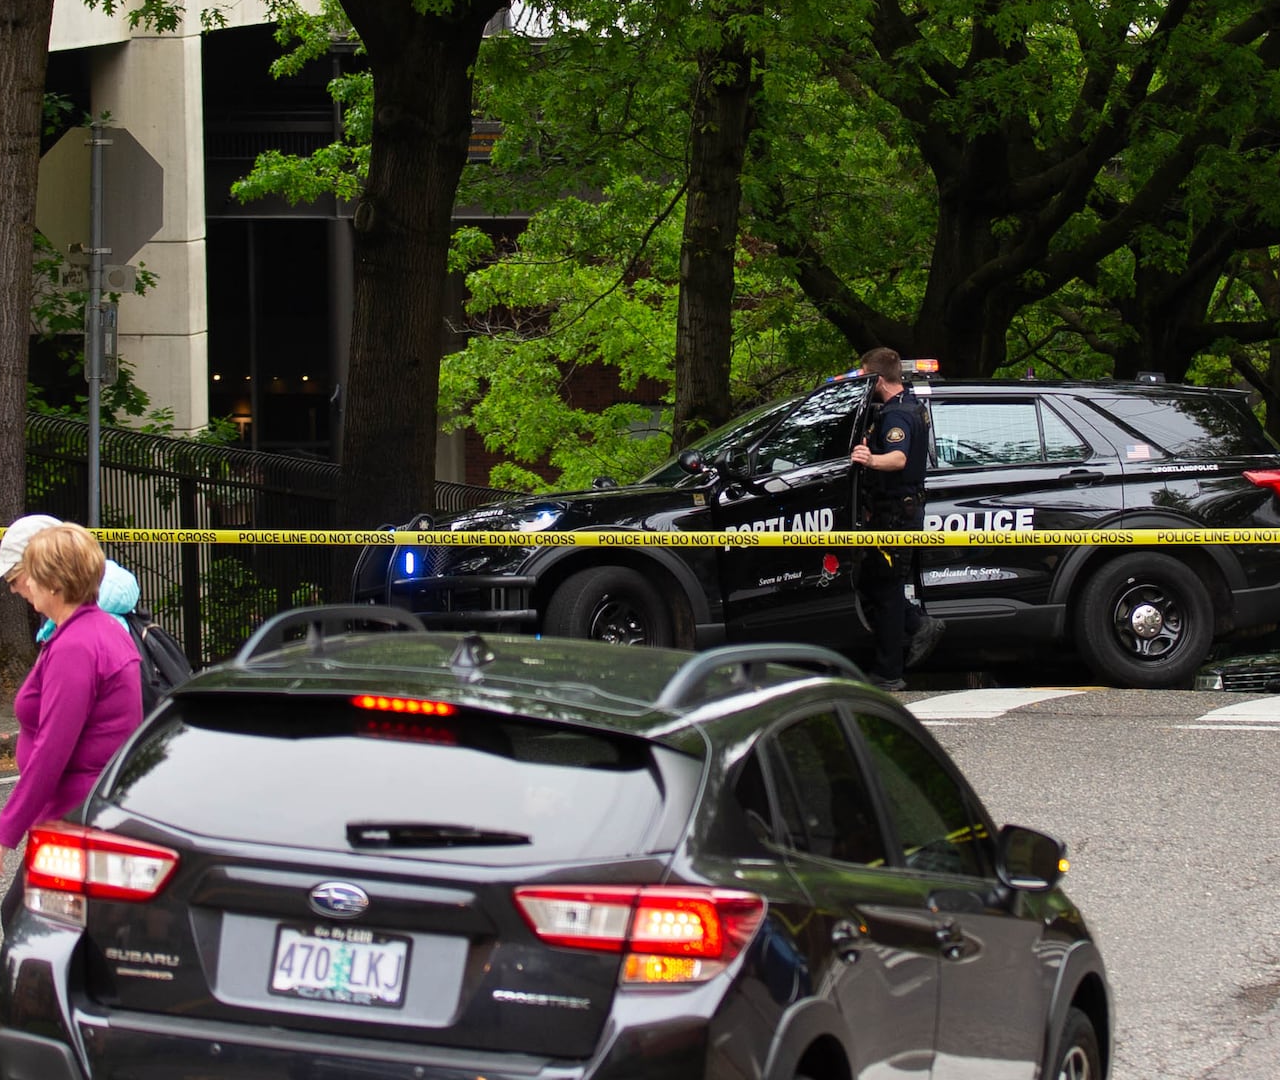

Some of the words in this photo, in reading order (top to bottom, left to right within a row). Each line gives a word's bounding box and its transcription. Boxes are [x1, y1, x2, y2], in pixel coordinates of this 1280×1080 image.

[923, 508, 1034, 532] POLICE
[106, 532, 131, 541] LINE
[133, 532, 150, 541] DO
[152, 532, 176, 541] NOT
[178, 533, 217, 542] CROSS
[239, 533, 277, 543] POLICE
[280, 533, 306, 543] LINE
[310, 534, 326, 544] DO
[329, 534, 352, 544] NOT
[355, 534, 394, 544] CROSS
[417, 534, 458, 544] POLICE
[462, 534, 486, 544] LINE
[489, 535, 505, 545] DO
[509, 535, 532, 545] NOT
[535, 535, 575, 545] CROSS
[599, 535, 640, 545] POLICE
[643, 535, 669, 545] LINE
[672, 535, 688, 545] DO
[693, 535, 715, 545] NOT
[718, 535, 759, 545] CROSS
[783, 535, 824, 545] POLICE
[828, 535, 853, 545] LINE
[857, 534, 873, 545] DO
[877, 534, 900, 545] NOT
[903, 534, 944, 545] CROSS
[969, 533, 1011, 544] POLICE
[1015, 533, 1040, 544] LINE
[1044, 532, 1060, 543] DO
[1065, 532, 1088, 543] NOT
[1091, 532, 1133, 543] CROSS
[1158, 531, 1200, 542] POLICE
[1205, 531, 1229, 542] LINE
[1233, 530, 1250, 541] DO
[1254, 530, 1278, 541] NOT
[929, 566, 970, 579] Dedicated
[980, 567, 1001, 576] Serve
[759, 577, 775, 587] Sworn
[783, 571, 802, 581] Protect
[104, 947, 180, 968] SUBARU
[279, 942, 331, 982] 470
[349, 949, 403, 990] LKJ
